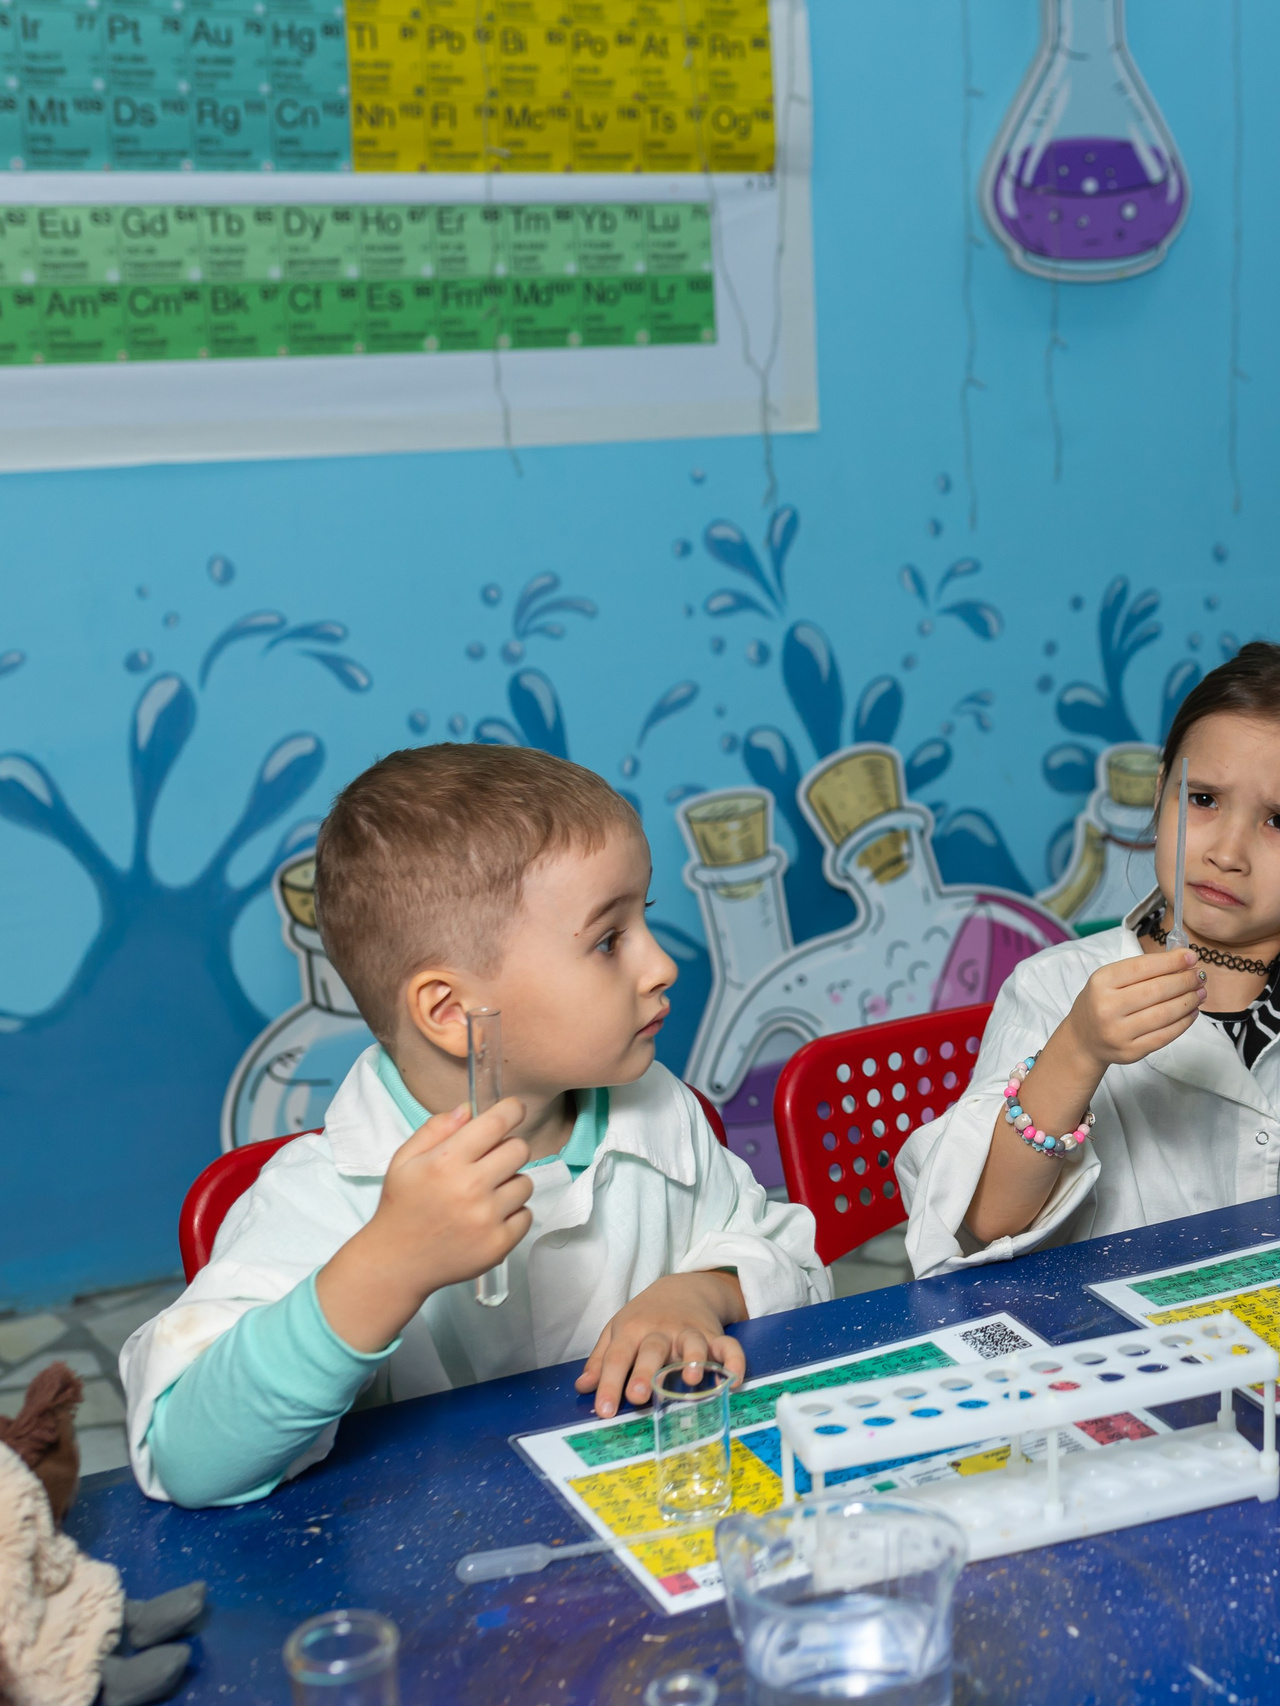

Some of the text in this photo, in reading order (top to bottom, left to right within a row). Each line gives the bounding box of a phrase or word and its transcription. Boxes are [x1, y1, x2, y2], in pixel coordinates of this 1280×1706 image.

[21, 14, 41, 41] Ir
[108, 13, 142, 46] Pt
[191, 18, 233, 47] Au
[272, 20, 317, 57] Hg
[427, 25, 466, 55] Pb
[572, 29, 608, 58] Po
[640, 32, 669, 59] At
[709, 33, 746, 61] Rn
[28, 97, 68, 127] Mt
[113, 96, 156, 127] Ds
[196, 97, 241, 137] Rg
[275, 98, 320, 130] Cn
[355, 101, 396, 130] Nh
[505, 104, 546, 132] Mc
[576, 106, 608, 132] Lv
[649, 105, 678, 134] Ts
[711, 105, 752, 141] Og
[38, 208, 81, 239] Eu
[122, 207, 168, 239] Gd
[206, 207, 245, 237] Tb
[284, 207, 326, 242] Dy
[361, 208, 403, 236] Ho
[437, 207, 466, 235] Er
[510, 206, 551, 234] Tm
[577, 206, 617, 234] Yb
[647, 206, 680, 233] Lu
[46, 291, 99, 318] Am
[128, 287, 182, 318] Cm
[211, 285, 250, 315] Bk
[288, 284, 323, 314] Cf
[367, 283, 404, 312] Es
[442, 282, 483, 308] Fm
[514, 282, 553, 307] Md
[583, 280, 621, 307] No
[651, 280, 676, 305] Lr
